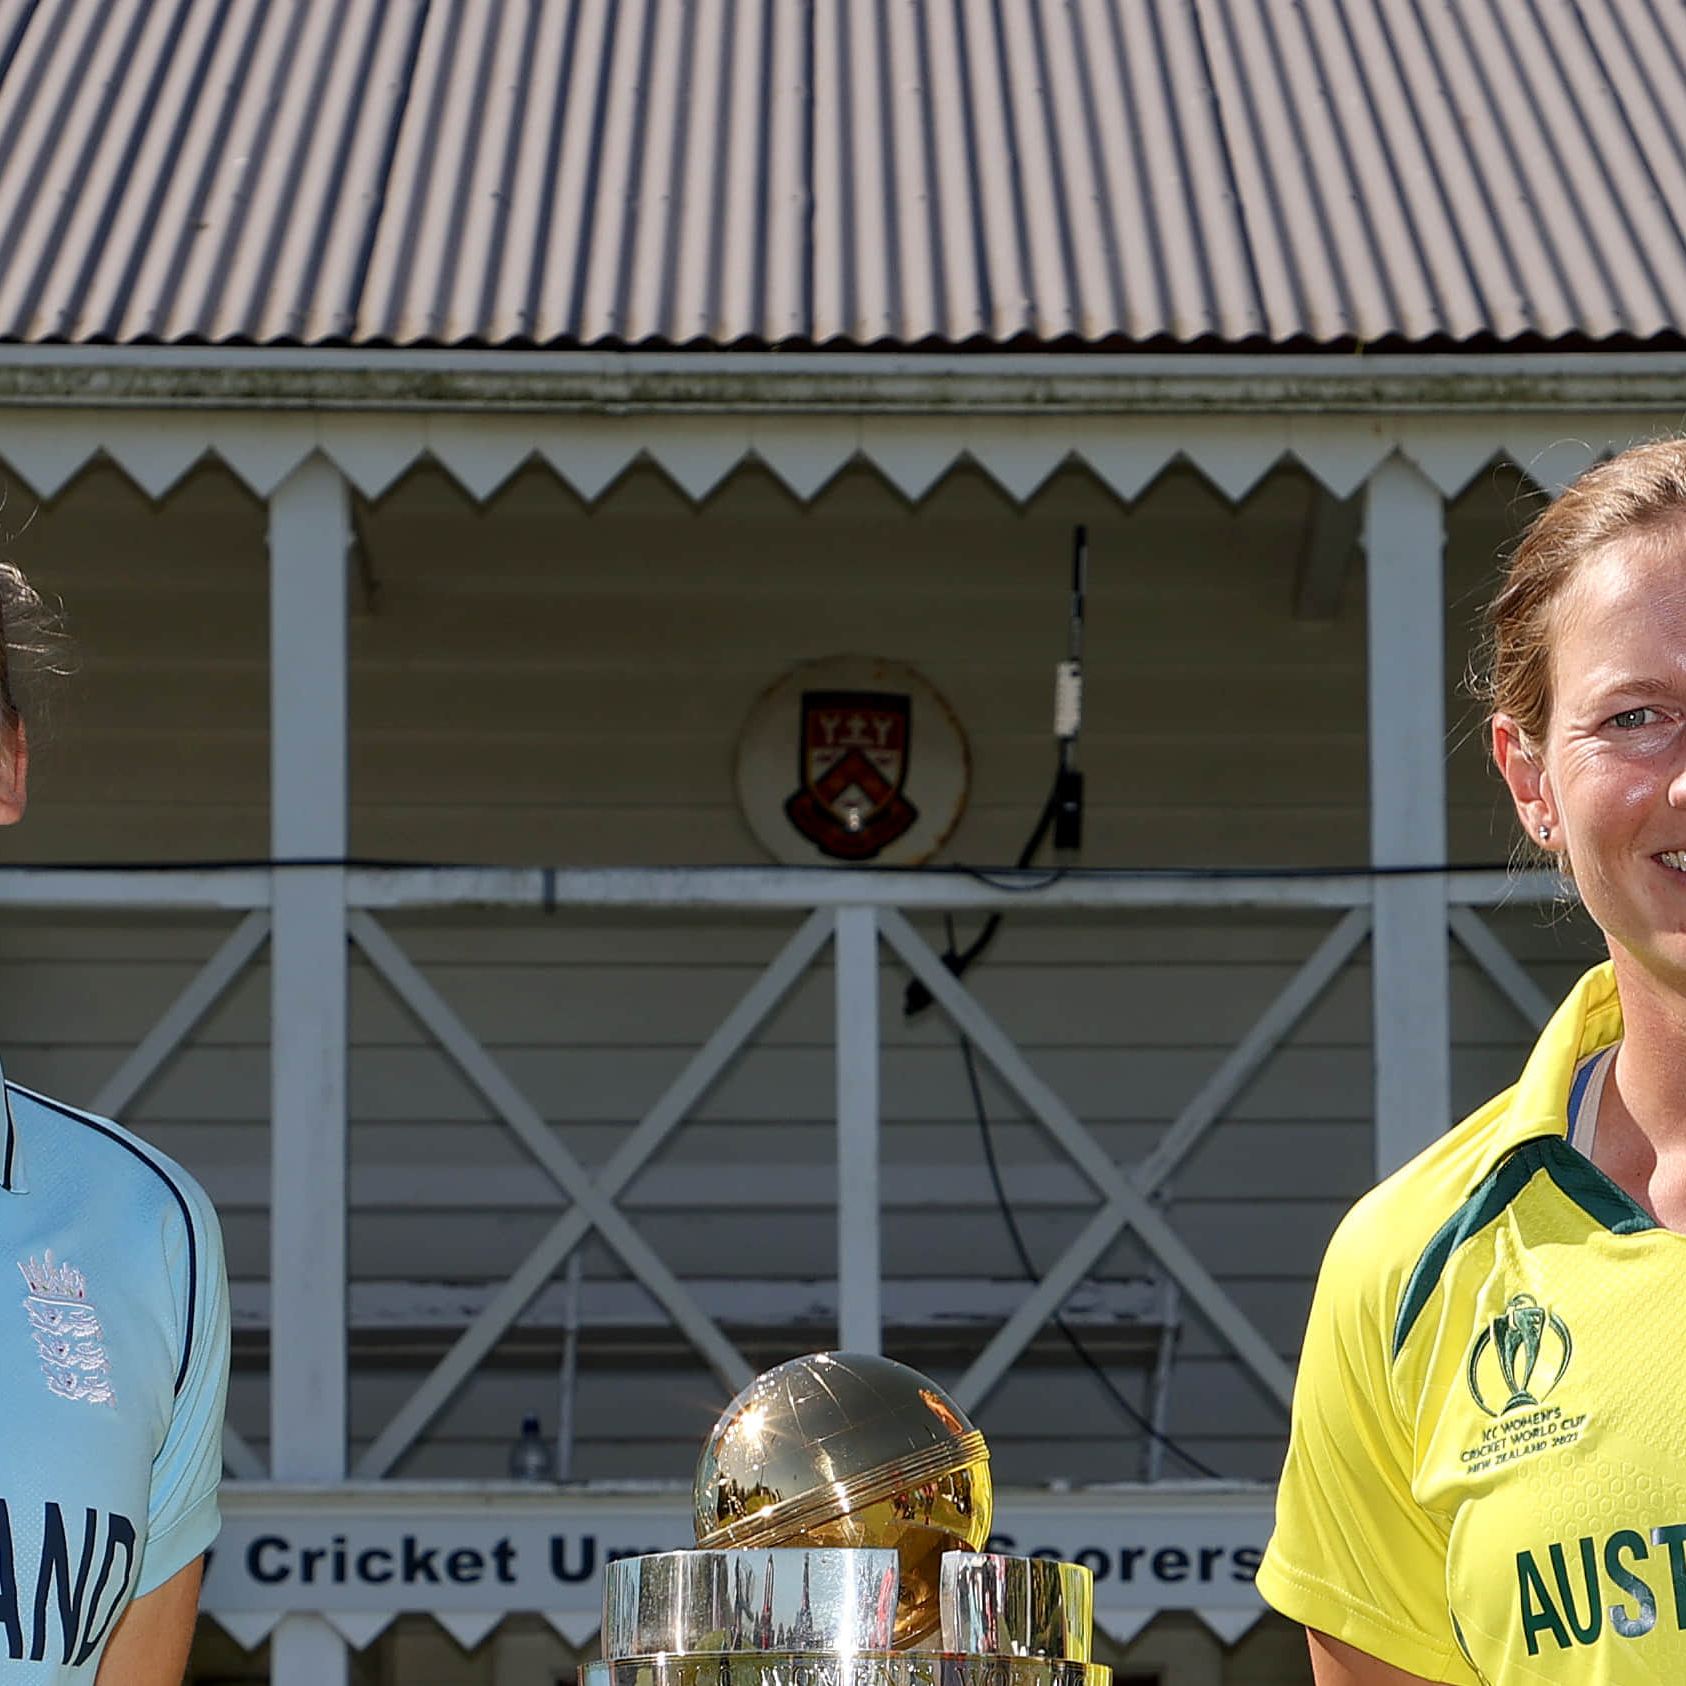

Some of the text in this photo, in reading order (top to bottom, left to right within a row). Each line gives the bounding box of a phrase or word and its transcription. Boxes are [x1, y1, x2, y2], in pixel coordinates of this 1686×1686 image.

[1460, 1413, 1587, 1463] CRICKET WORLD CUP
[245, 1534, 518, 1585] Cricket
[984, 1532, 1262, 1584] orers
